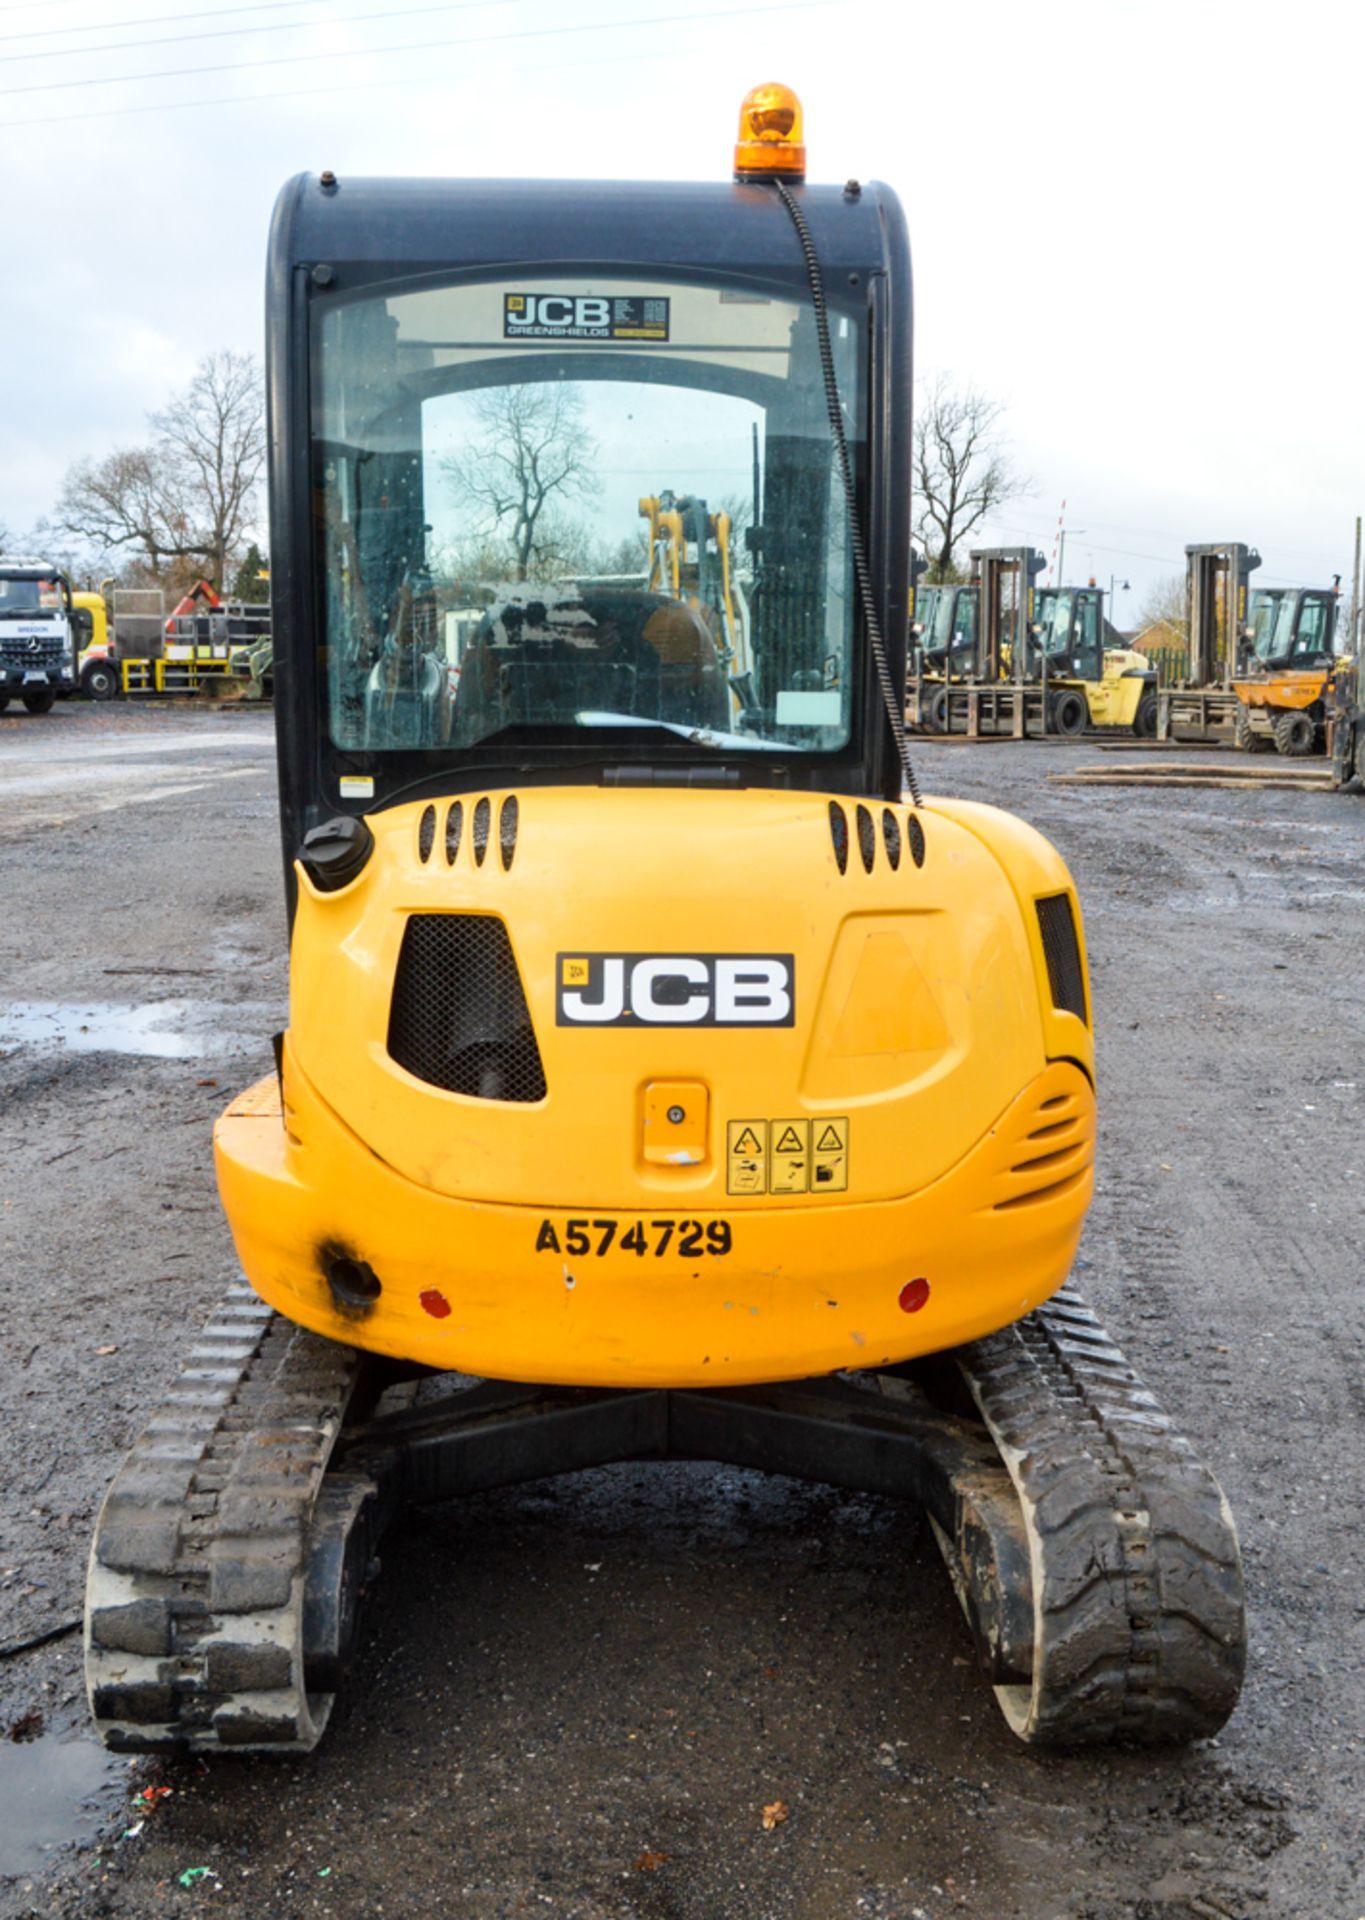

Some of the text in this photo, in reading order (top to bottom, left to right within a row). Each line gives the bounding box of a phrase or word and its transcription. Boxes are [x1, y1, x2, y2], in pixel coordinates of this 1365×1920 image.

[507, 296, 610, 327] JCB
[507, 326, 610, 337] GREENSHIELDS
[562, 958, 790, 1022] JCB
[536, 1219, 732, 1257] A574729
